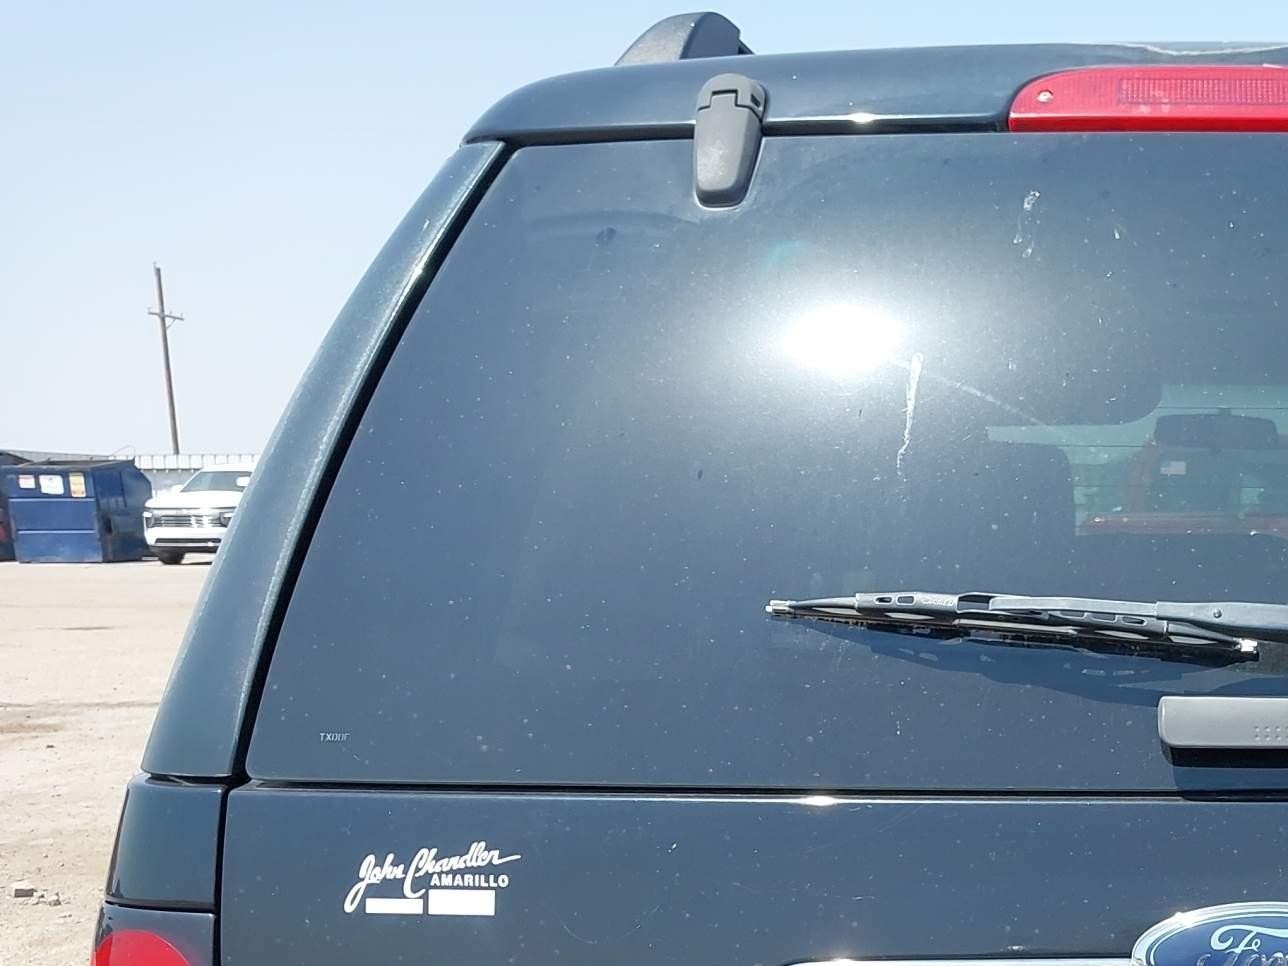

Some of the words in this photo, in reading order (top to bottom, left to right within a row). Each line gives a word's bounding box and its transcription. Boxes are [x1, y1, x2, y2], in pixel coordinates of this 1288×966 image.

[343, 853, 406, 913] John
[403, 841, 521, 899] Chandler
[430, 874, 509, 888] AMARILLO
